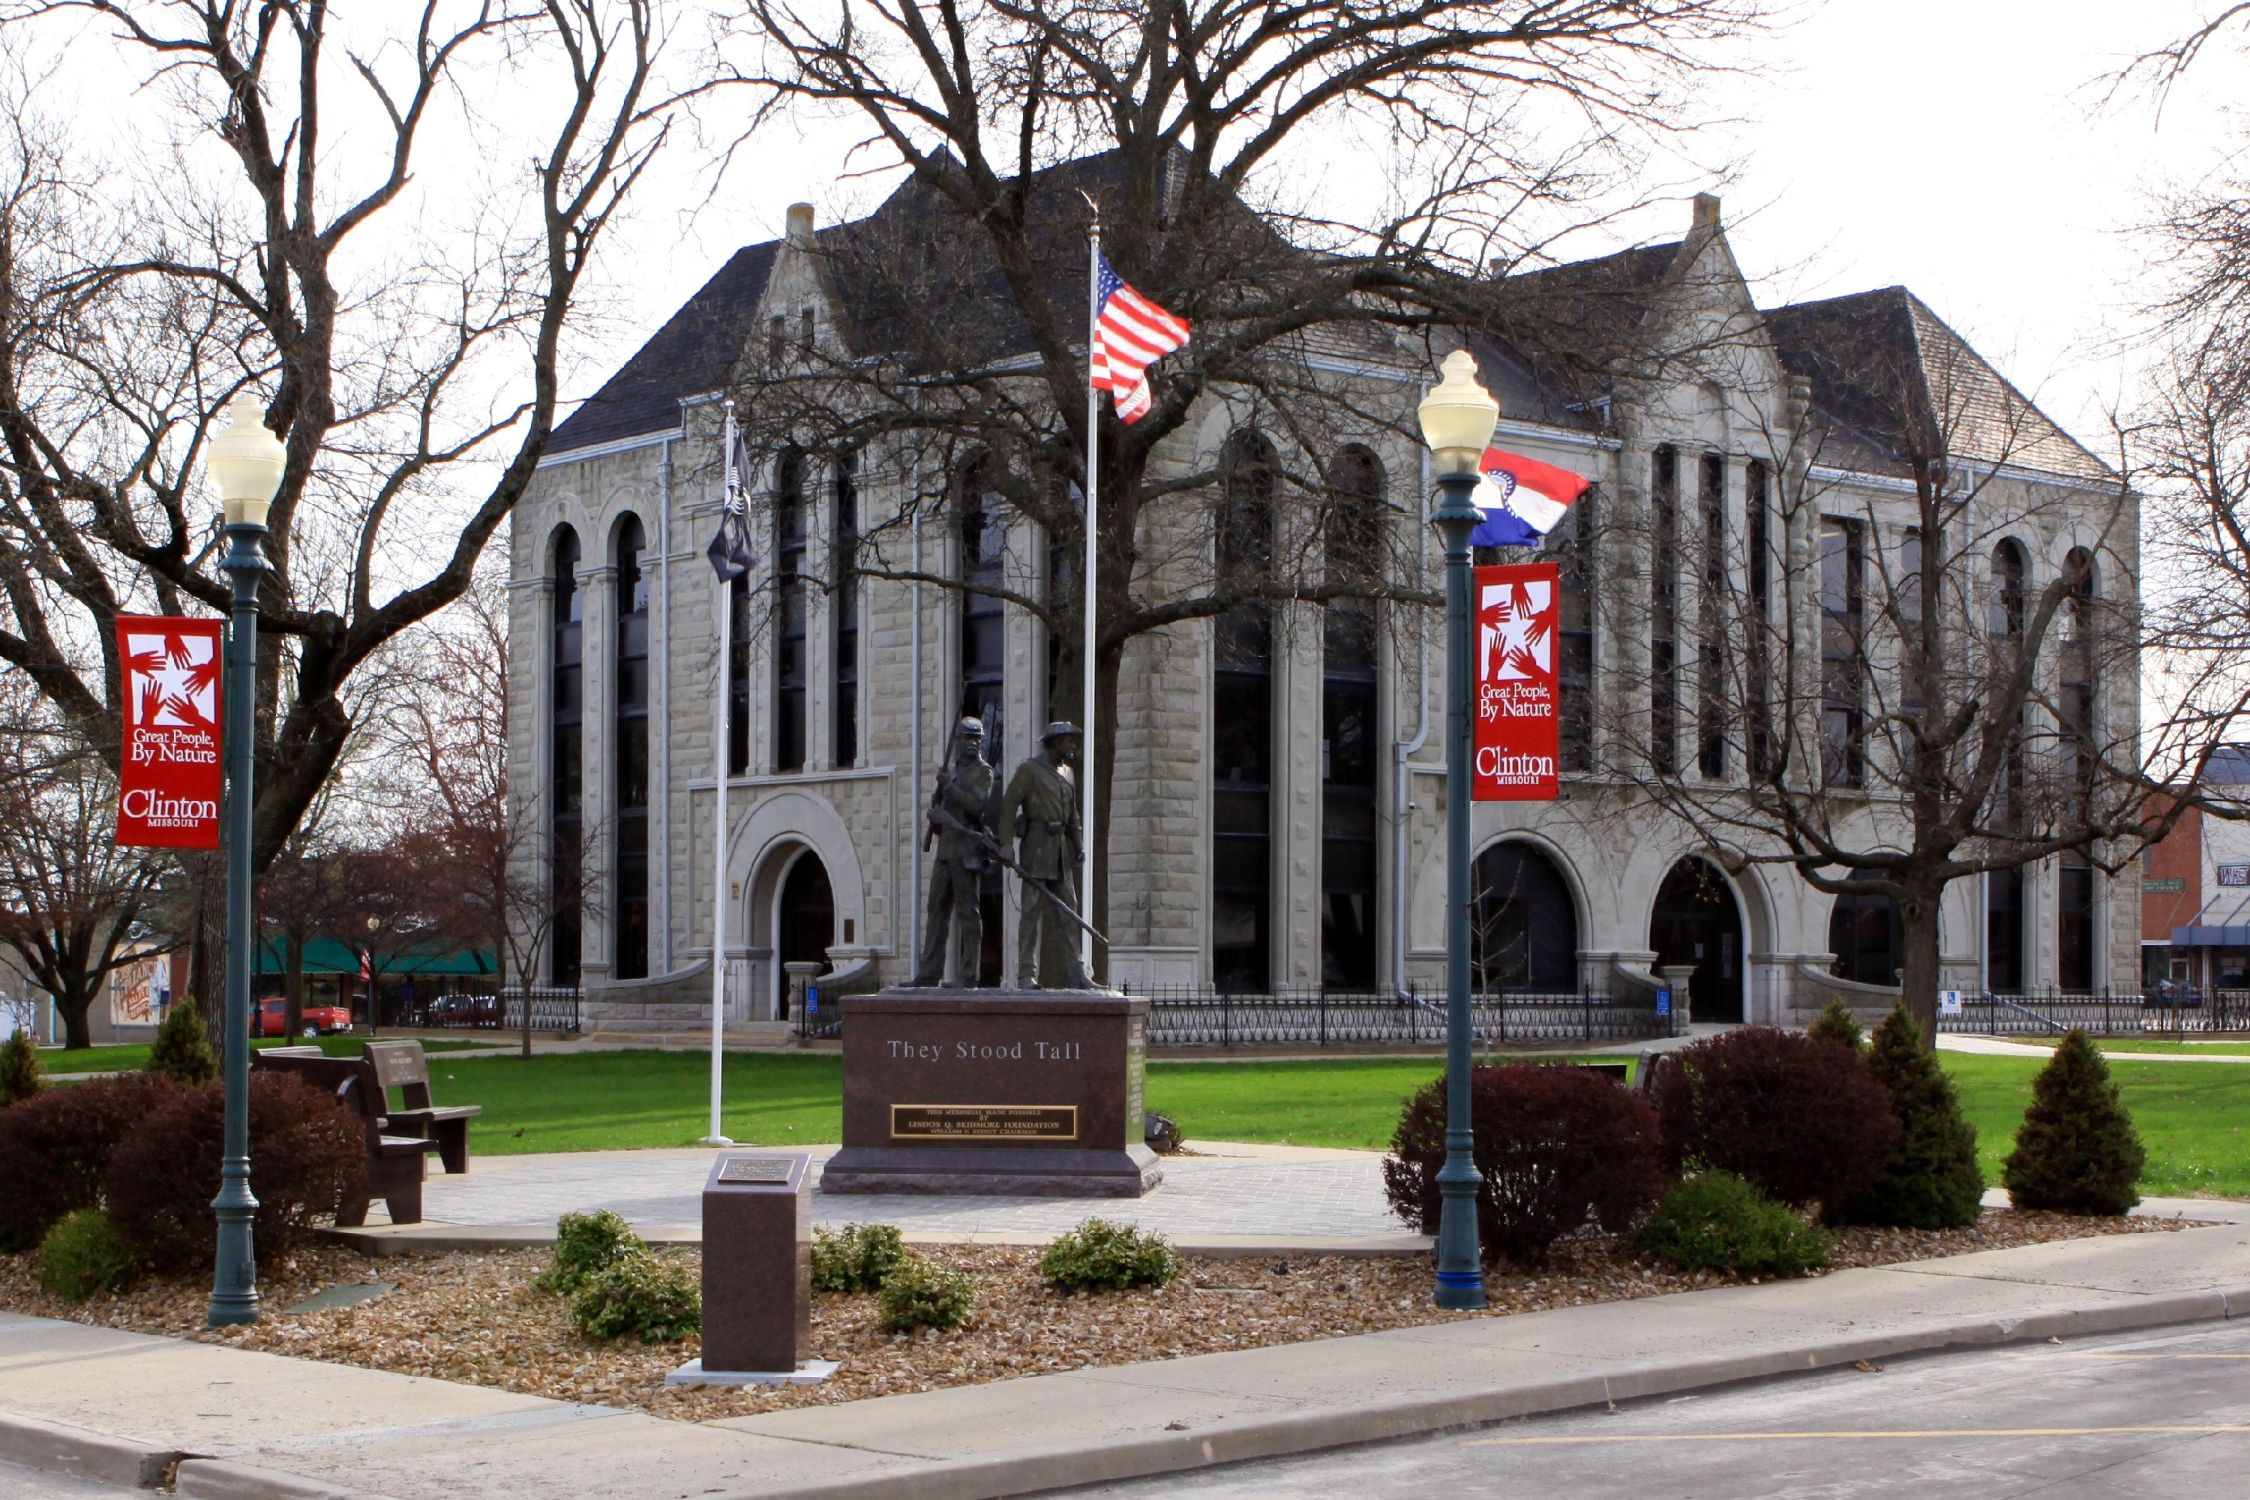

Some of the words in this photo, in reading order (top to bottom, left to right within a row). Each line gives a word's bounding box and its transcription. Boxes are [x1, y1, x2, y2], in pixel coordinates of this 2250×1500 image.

[1480, 683, 1511, 699] Great
[1513, 681, 1550, 700] People,
[1480, 698, 1499, 723] By
[1501, 698, 1552, 717] Nature
[133, 728, 170, 743] Great
[172, 729, 215, 748] People,
[131, 742, 155, 767] By
[158, 743, 217, 763] Nature
[1476, 745, 1555, 776] Clinton
[1496, 776, 1540, 785] MISSOURI
[122, 788, 218, 819] Clinton
[147, 818, 199, 828] MISSOURI
[887, 1040, 943, 1062] They
[956, 1041, 1022, 1059] Stood
[1034, 1041, 1081, 1060] Tall
